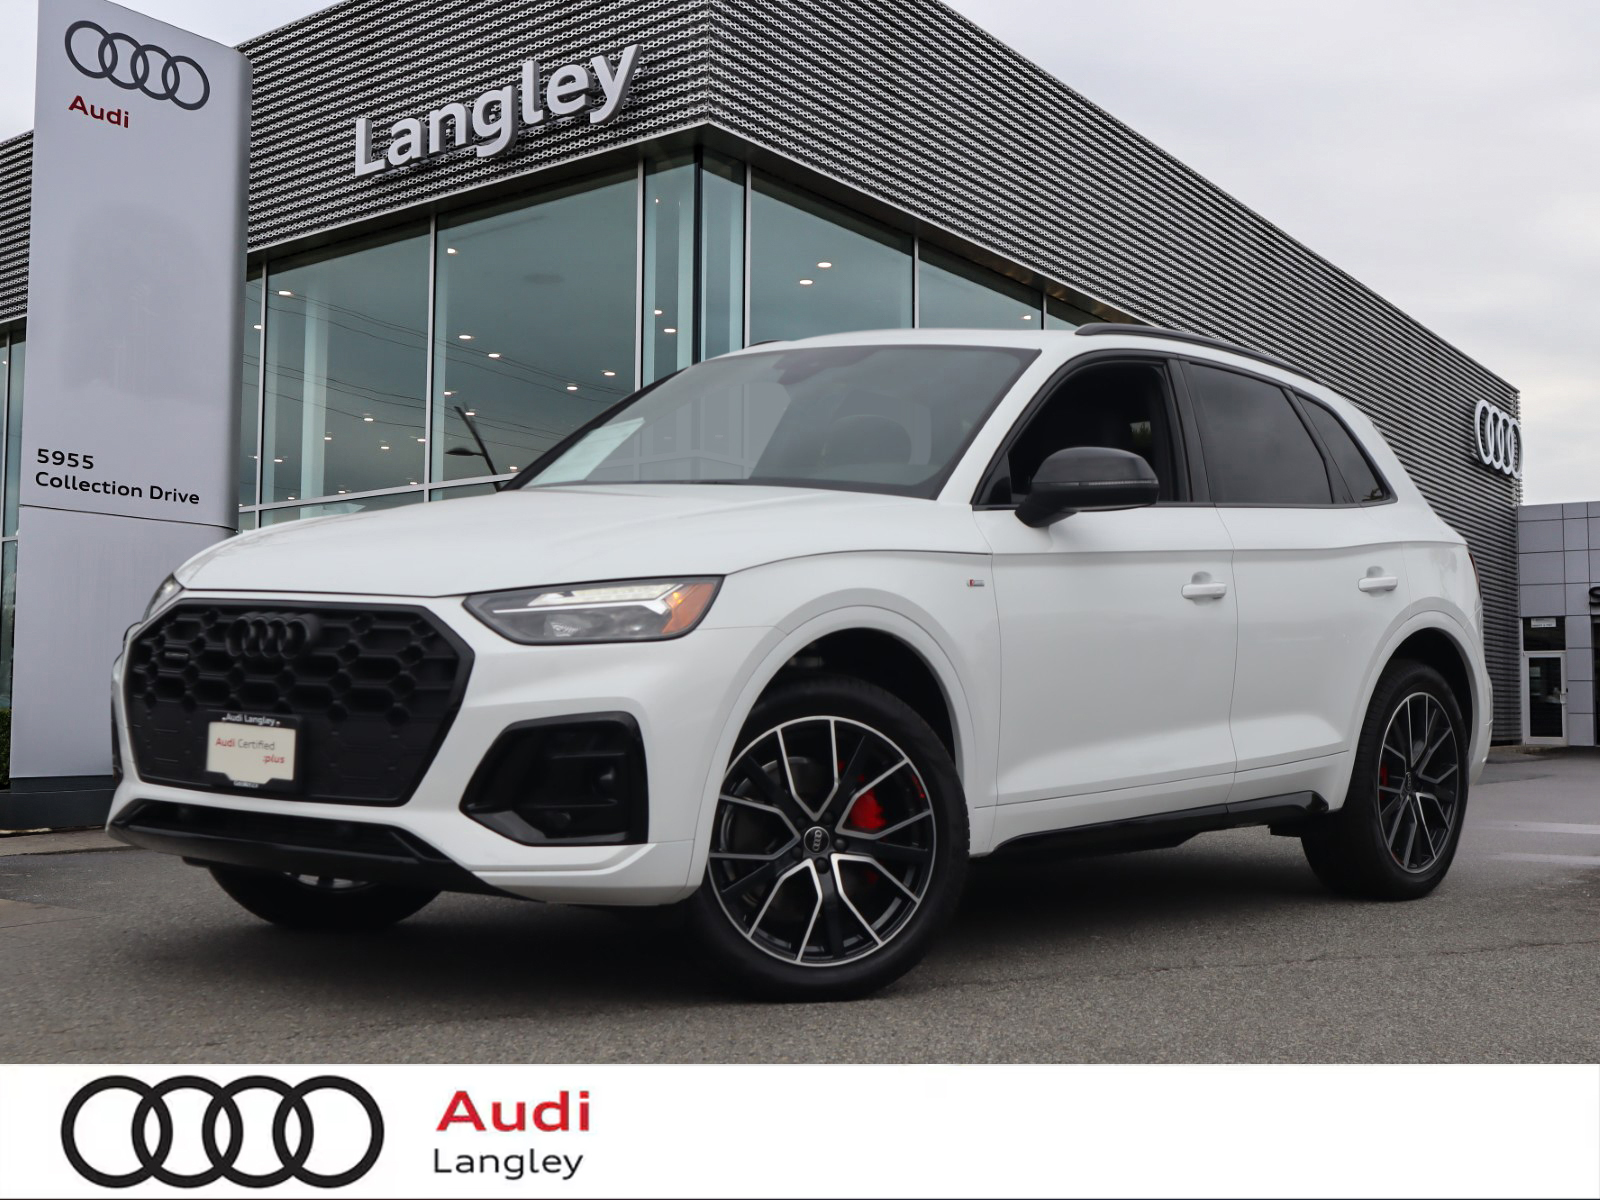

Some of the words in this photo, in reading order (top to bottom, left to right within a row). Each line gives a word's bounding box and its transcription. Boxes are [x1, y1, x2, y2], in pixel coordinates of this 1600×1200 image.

[68, 95, 129, 128] Audi
[354, 44, 643, 177] Langley
[37, 448, 94, 470] 5955
[35, 471, 142, 498] Collection
[149, 485, 200, 505] Drive
[226, 712, 243, 721] Audi
[243, 714, 275, 727] Langley
[216, 738, 235, 748] Audi
[237, 738, 275, 751] Certified
